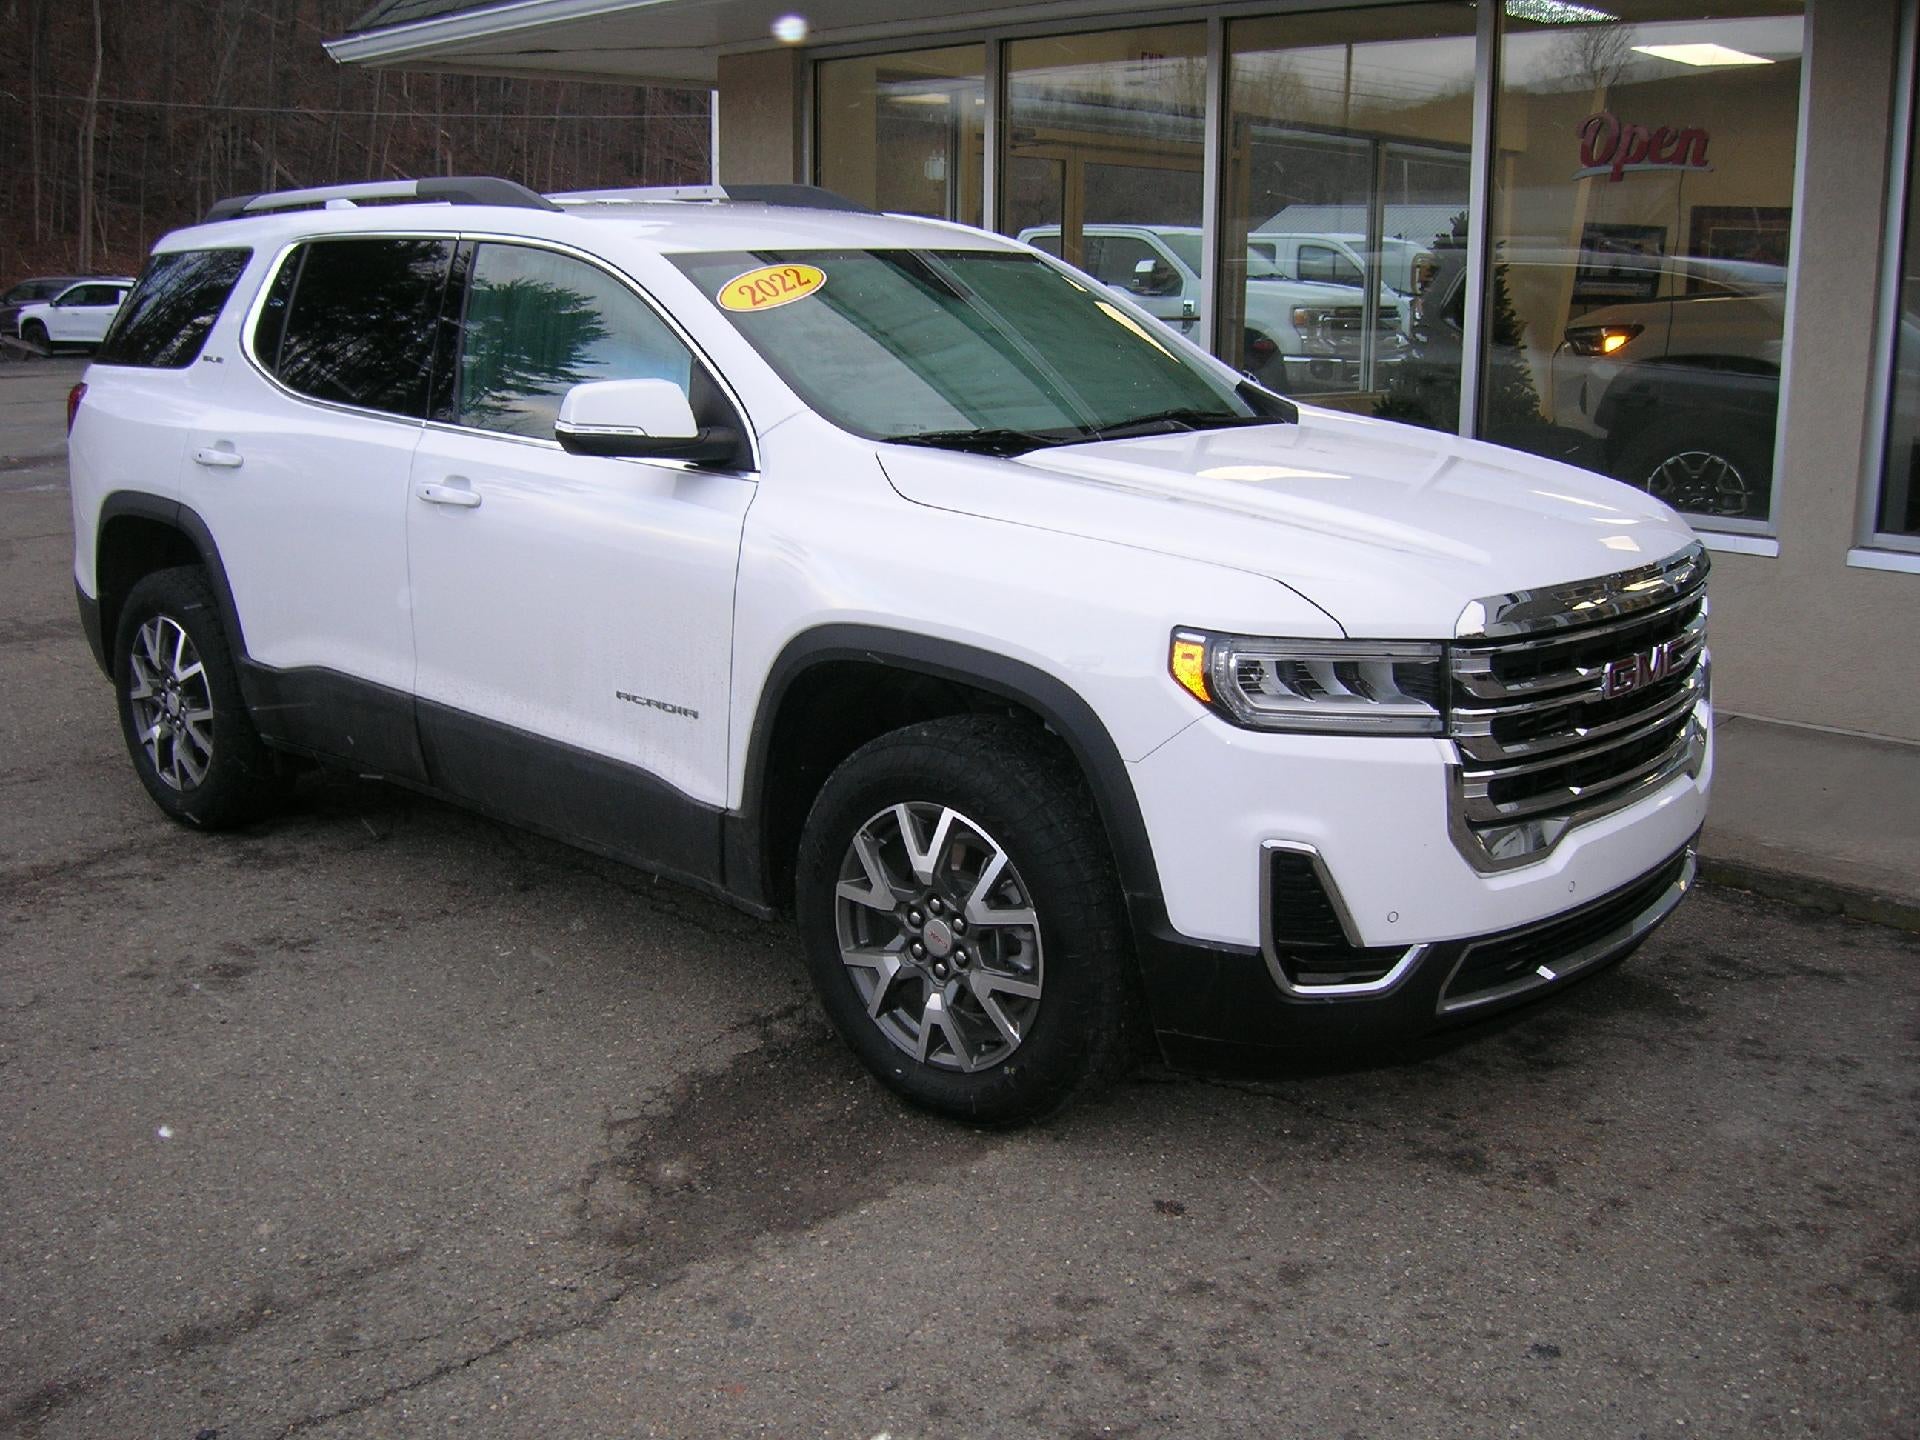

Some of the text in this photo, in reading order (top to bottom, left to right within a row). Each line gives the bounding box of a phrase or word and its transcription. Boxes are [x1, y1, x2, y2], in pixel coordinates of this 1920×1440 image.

[1576, 112, 1709, 182] Open
[738, 268, 811, 305] 2022
[1603, 640, 1687, 699] GMC
[616, 690, 698, 719] ACADIA
